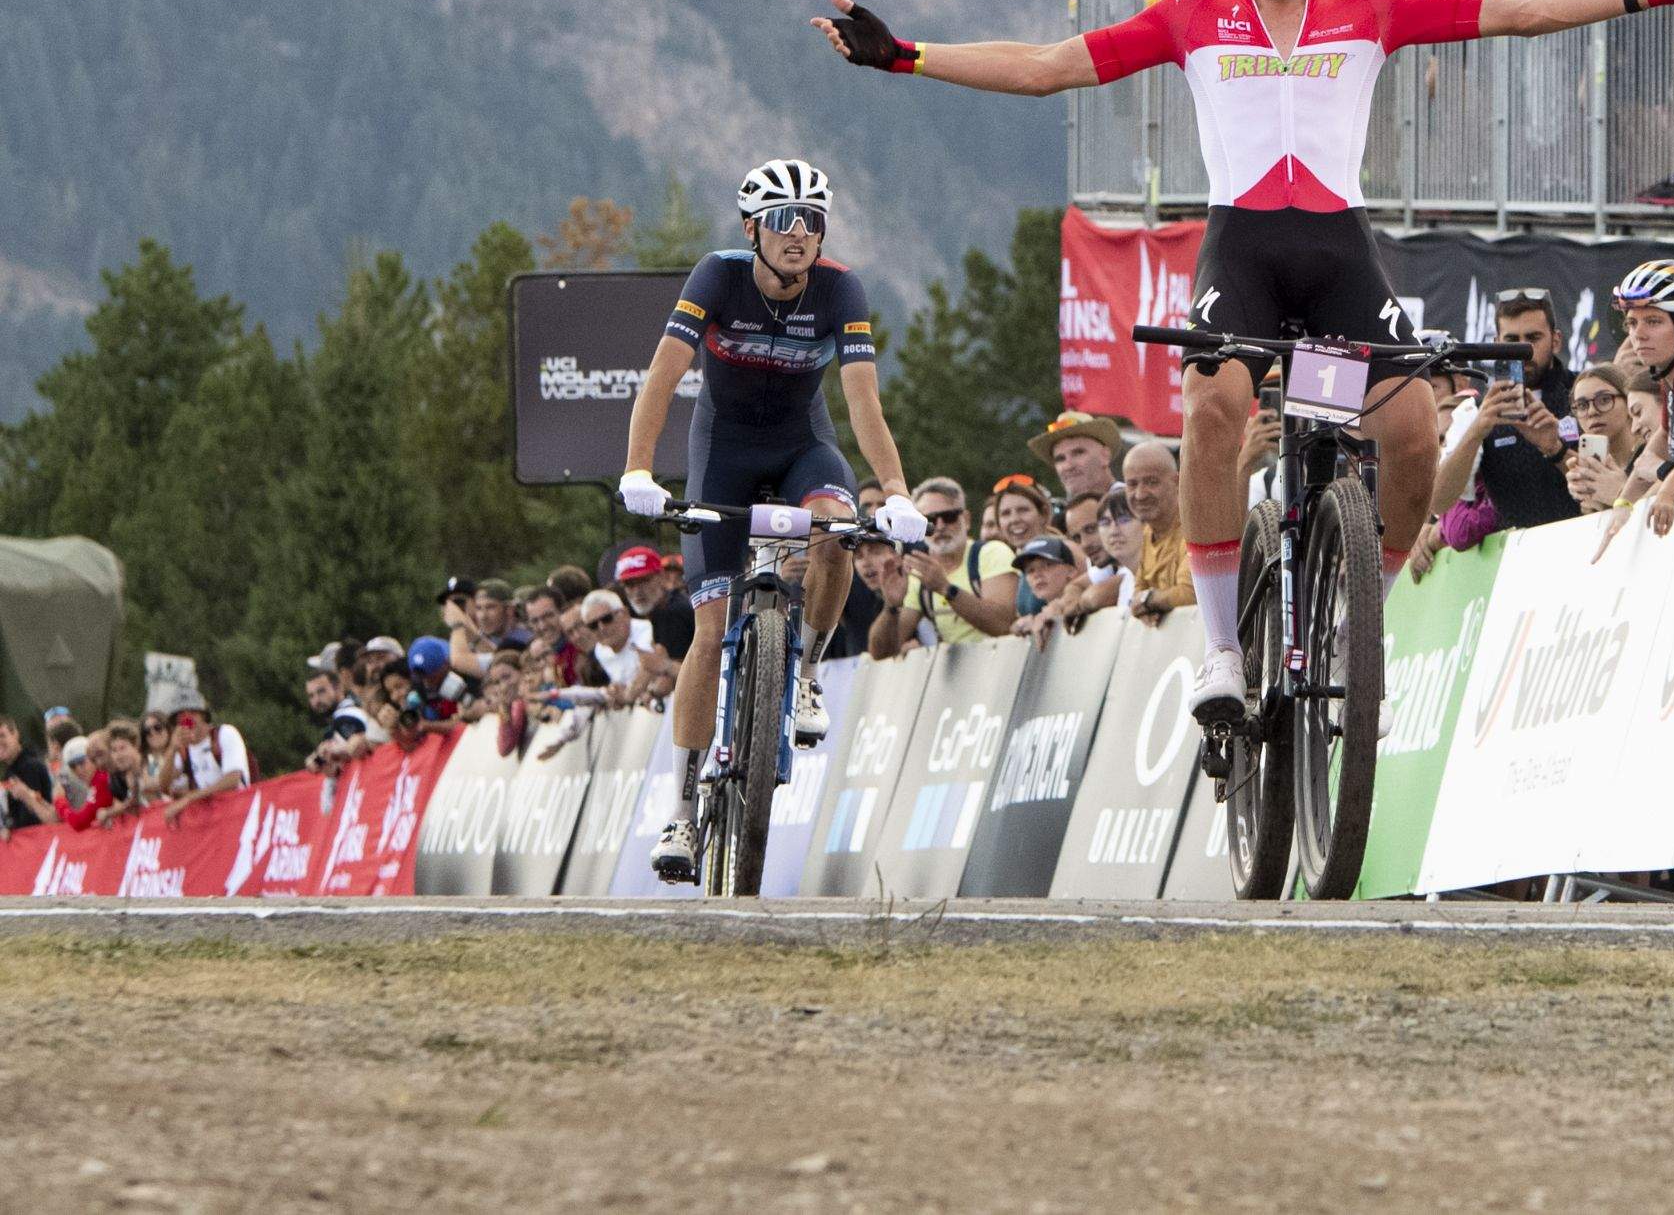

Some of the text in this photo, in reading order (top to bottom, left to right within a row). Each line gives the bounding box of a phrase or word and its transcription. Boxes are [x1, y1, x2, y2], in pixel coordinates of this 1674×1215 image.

[731, 320, 763, 332] Santini
[719, 337, 823, 363] TREK
[541, 385, 632, 400] WORLD
[1317, 364, 1337, 398] 1
[770, 508, 792, 534] 6
[1511, 586, 1630, 731] vittoria
[927, 703, 1002, 773] GoPro
[1088, 807, 1175, 864] OAKLEY
